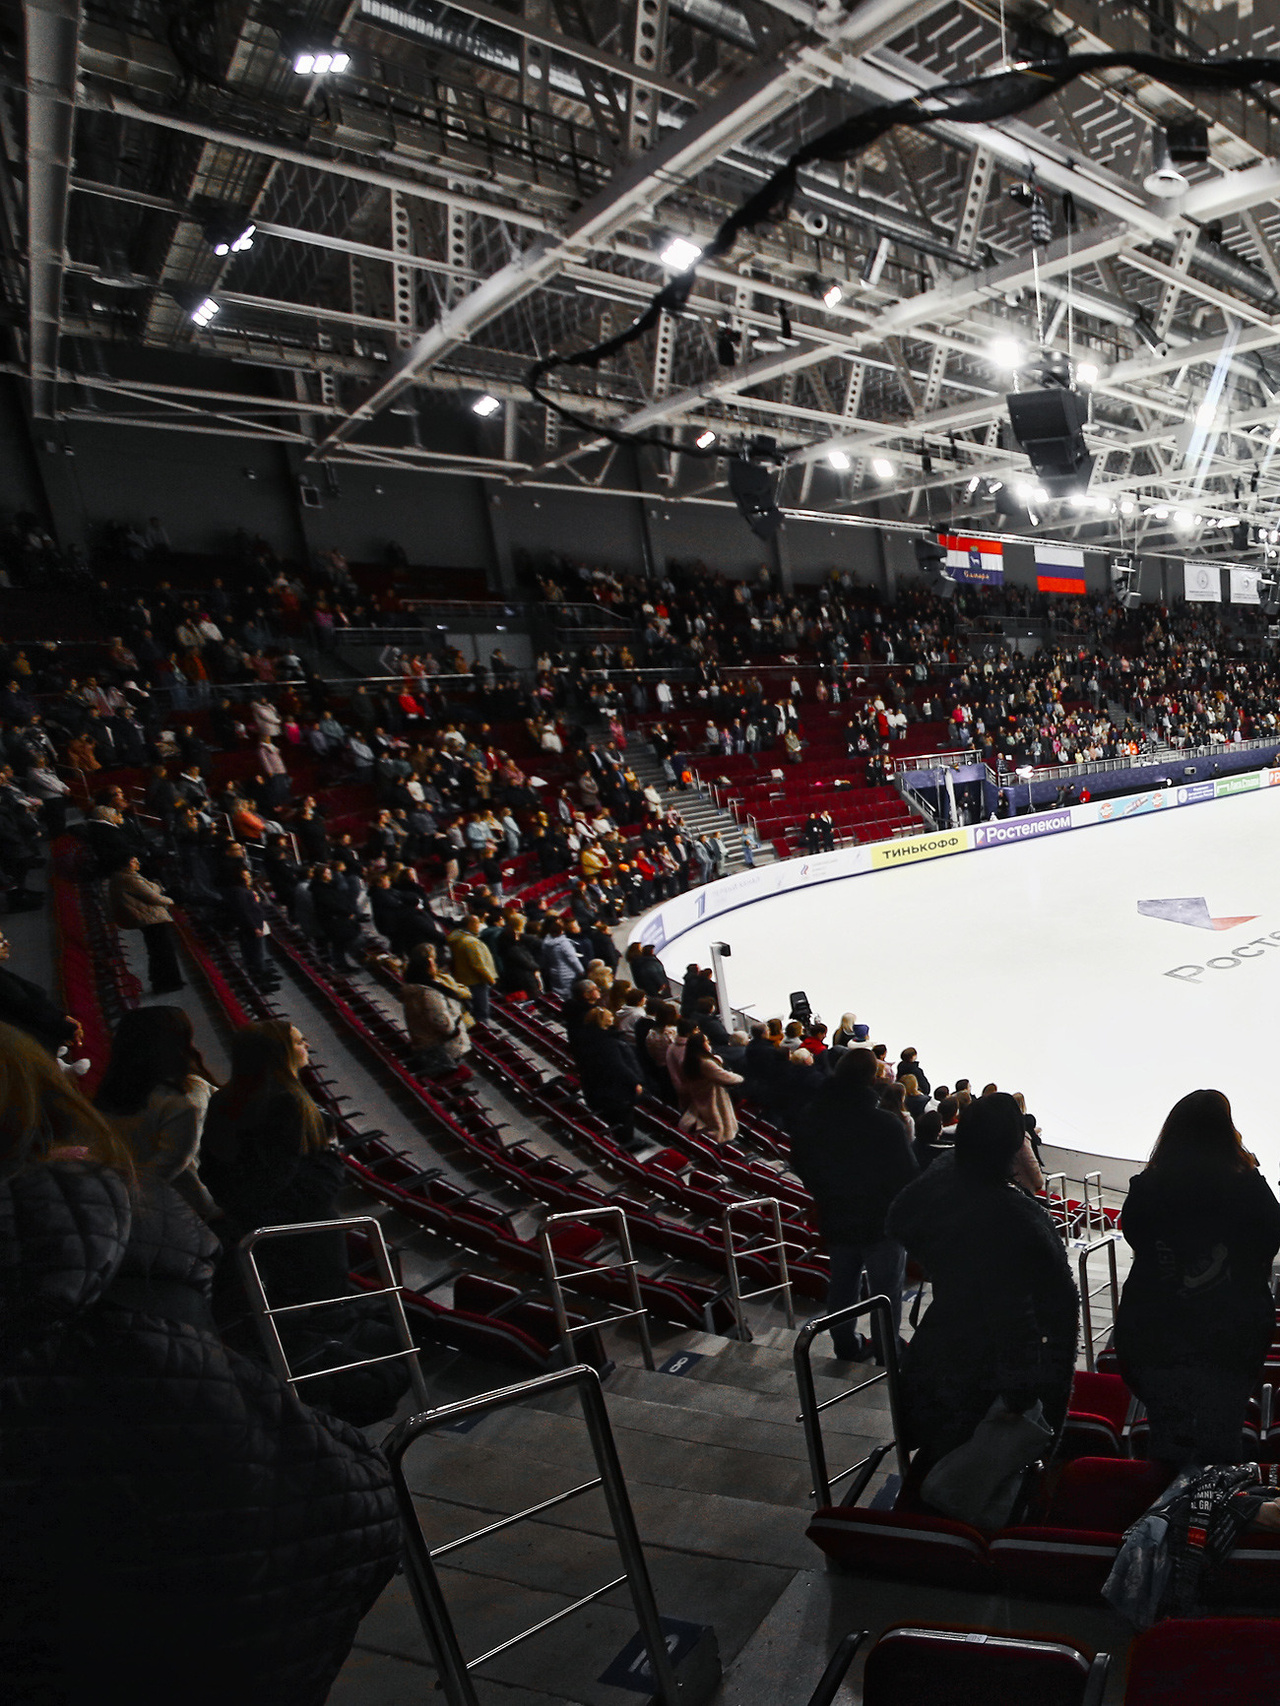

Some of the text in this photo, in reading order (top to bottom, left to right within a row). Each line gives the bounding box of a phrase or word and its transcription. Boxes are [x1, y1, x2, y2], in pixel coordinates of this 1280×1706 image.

[986, 815, 1071, 843] Ростелеком
[882, 837, 959, 859] ТИНЬКОФФ
[669, 1356, 689, 1373] 8
